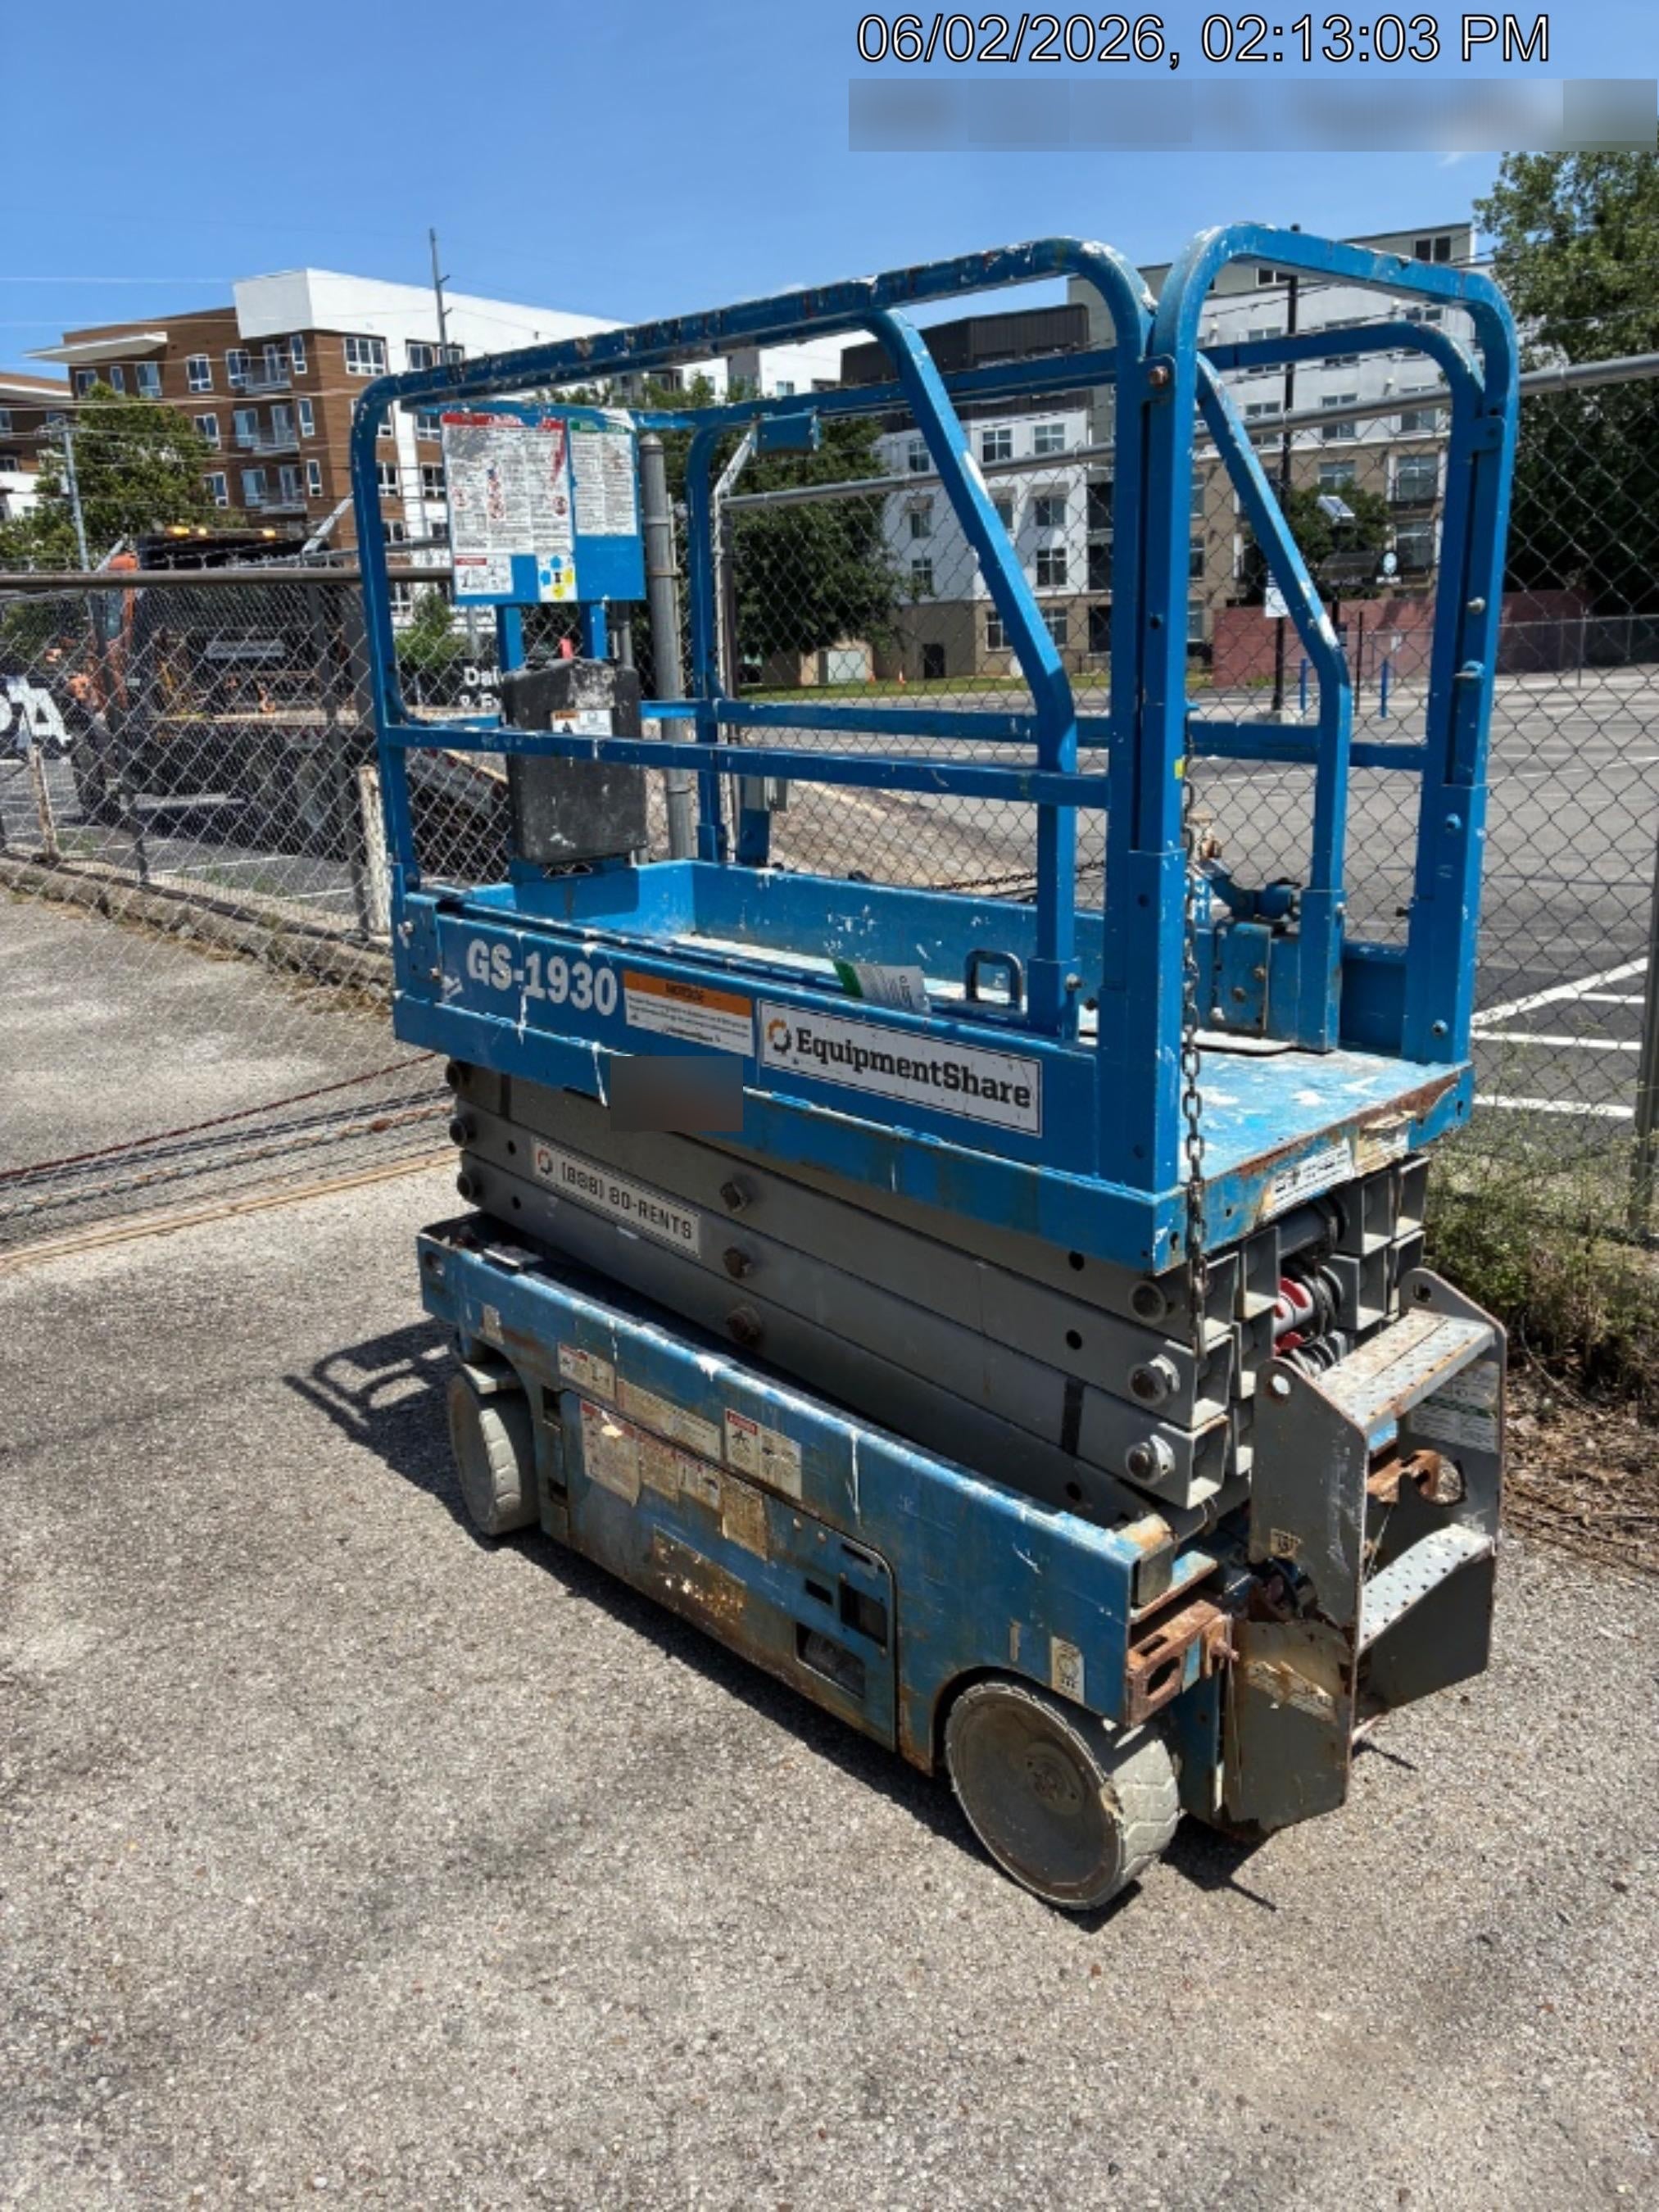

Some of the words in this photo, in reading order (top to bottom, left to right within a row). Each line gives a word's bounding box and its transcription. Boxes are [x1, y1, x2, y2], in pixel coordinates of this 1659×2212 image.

[466, 938, 618, 1016] GS-1930
[796, 1027, 1031, 1108] EquipmentShare
[609, 1185, 692, 1240] 80-RENTS
